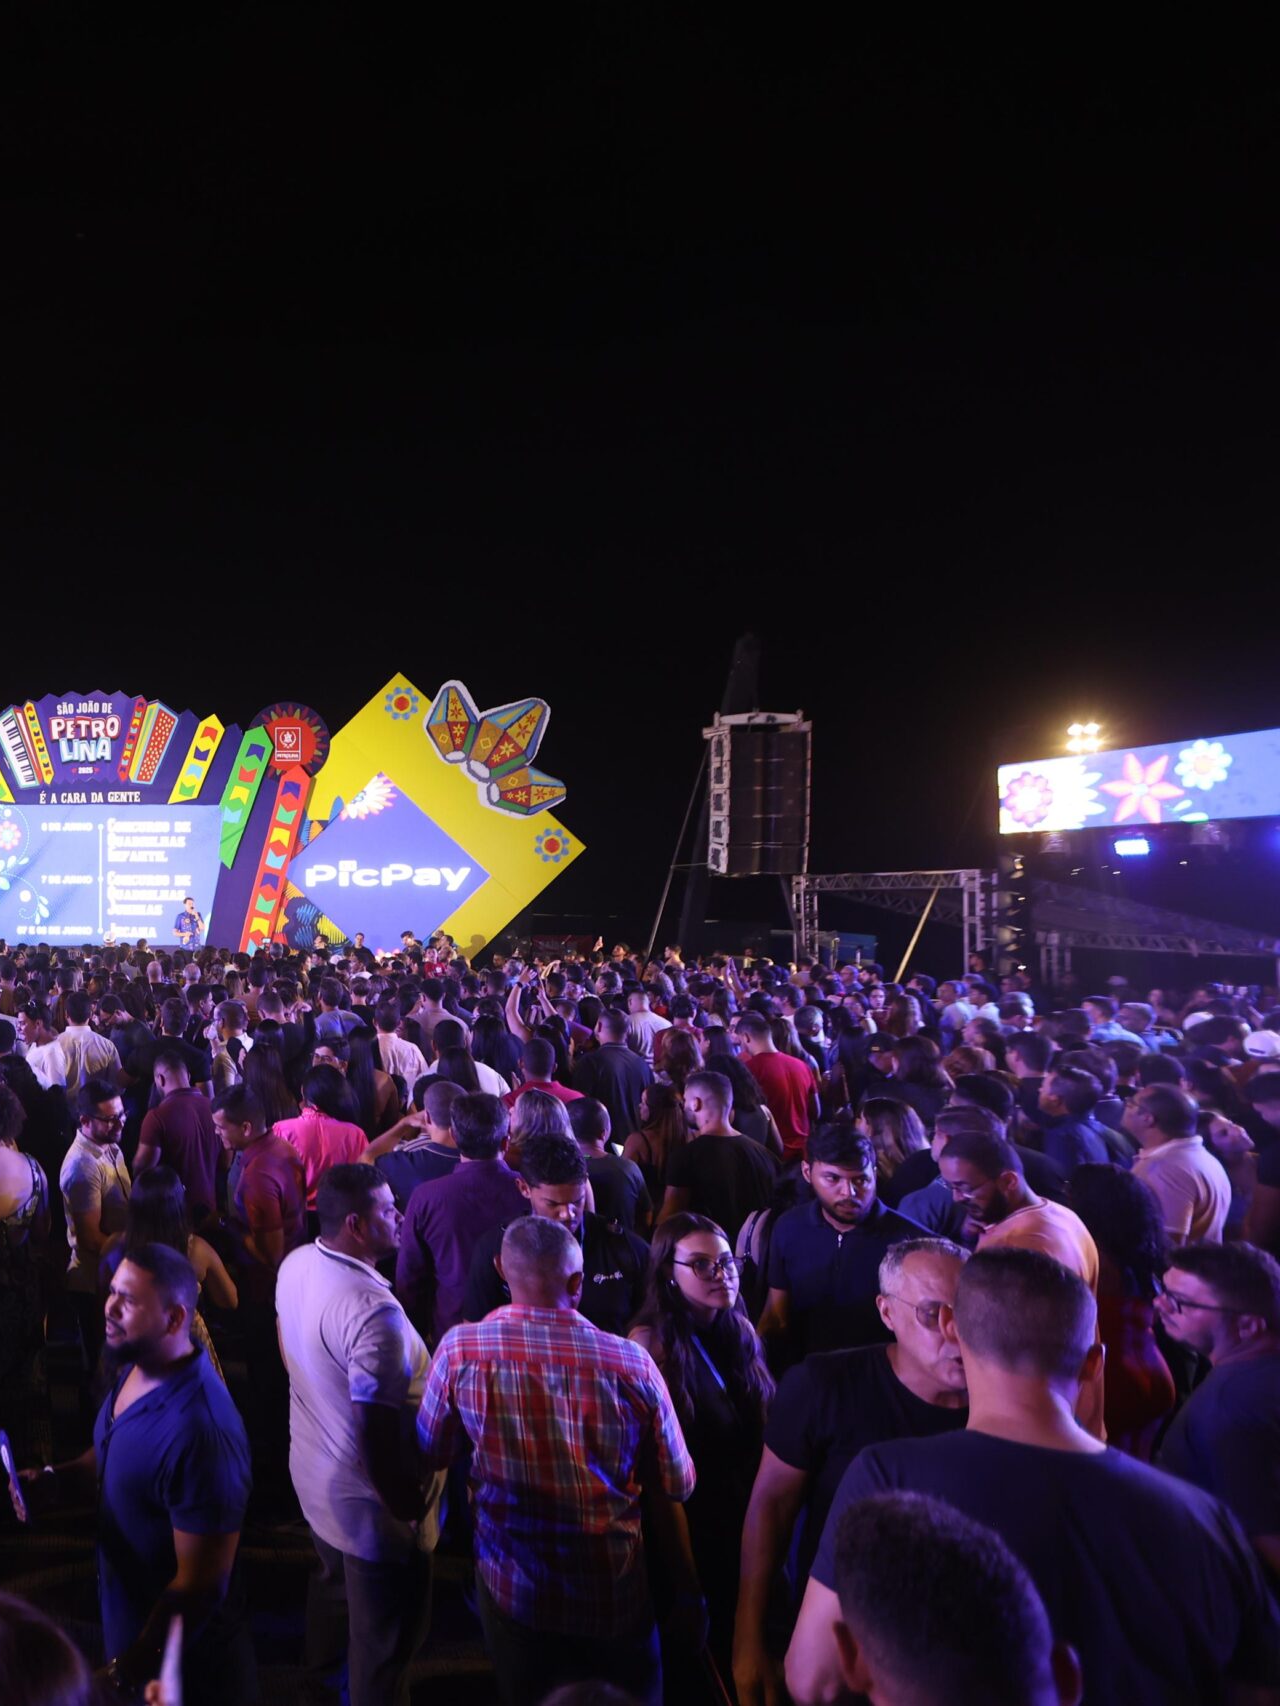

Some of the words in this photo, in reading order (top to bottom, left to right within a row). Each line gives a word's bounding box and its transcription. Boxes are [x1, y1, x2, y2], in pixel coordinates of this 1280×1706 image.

[56, 702, 74, 715] SÃO
[76, 700, 98, 714] JOÃO
[101, 702, 113, 714] DE
[50, 715, 120, 740] PETRO
[60, 737, 112, 762] LINA
[39, 790, 47, 804] É
[50, 793, 57, 804] A
[61, 792, 87, 804] CARA
[91, 791, 104, 803] DA
[108, 791, 141, 803] GENTE
[305, 860, 472, 891] PicPay
